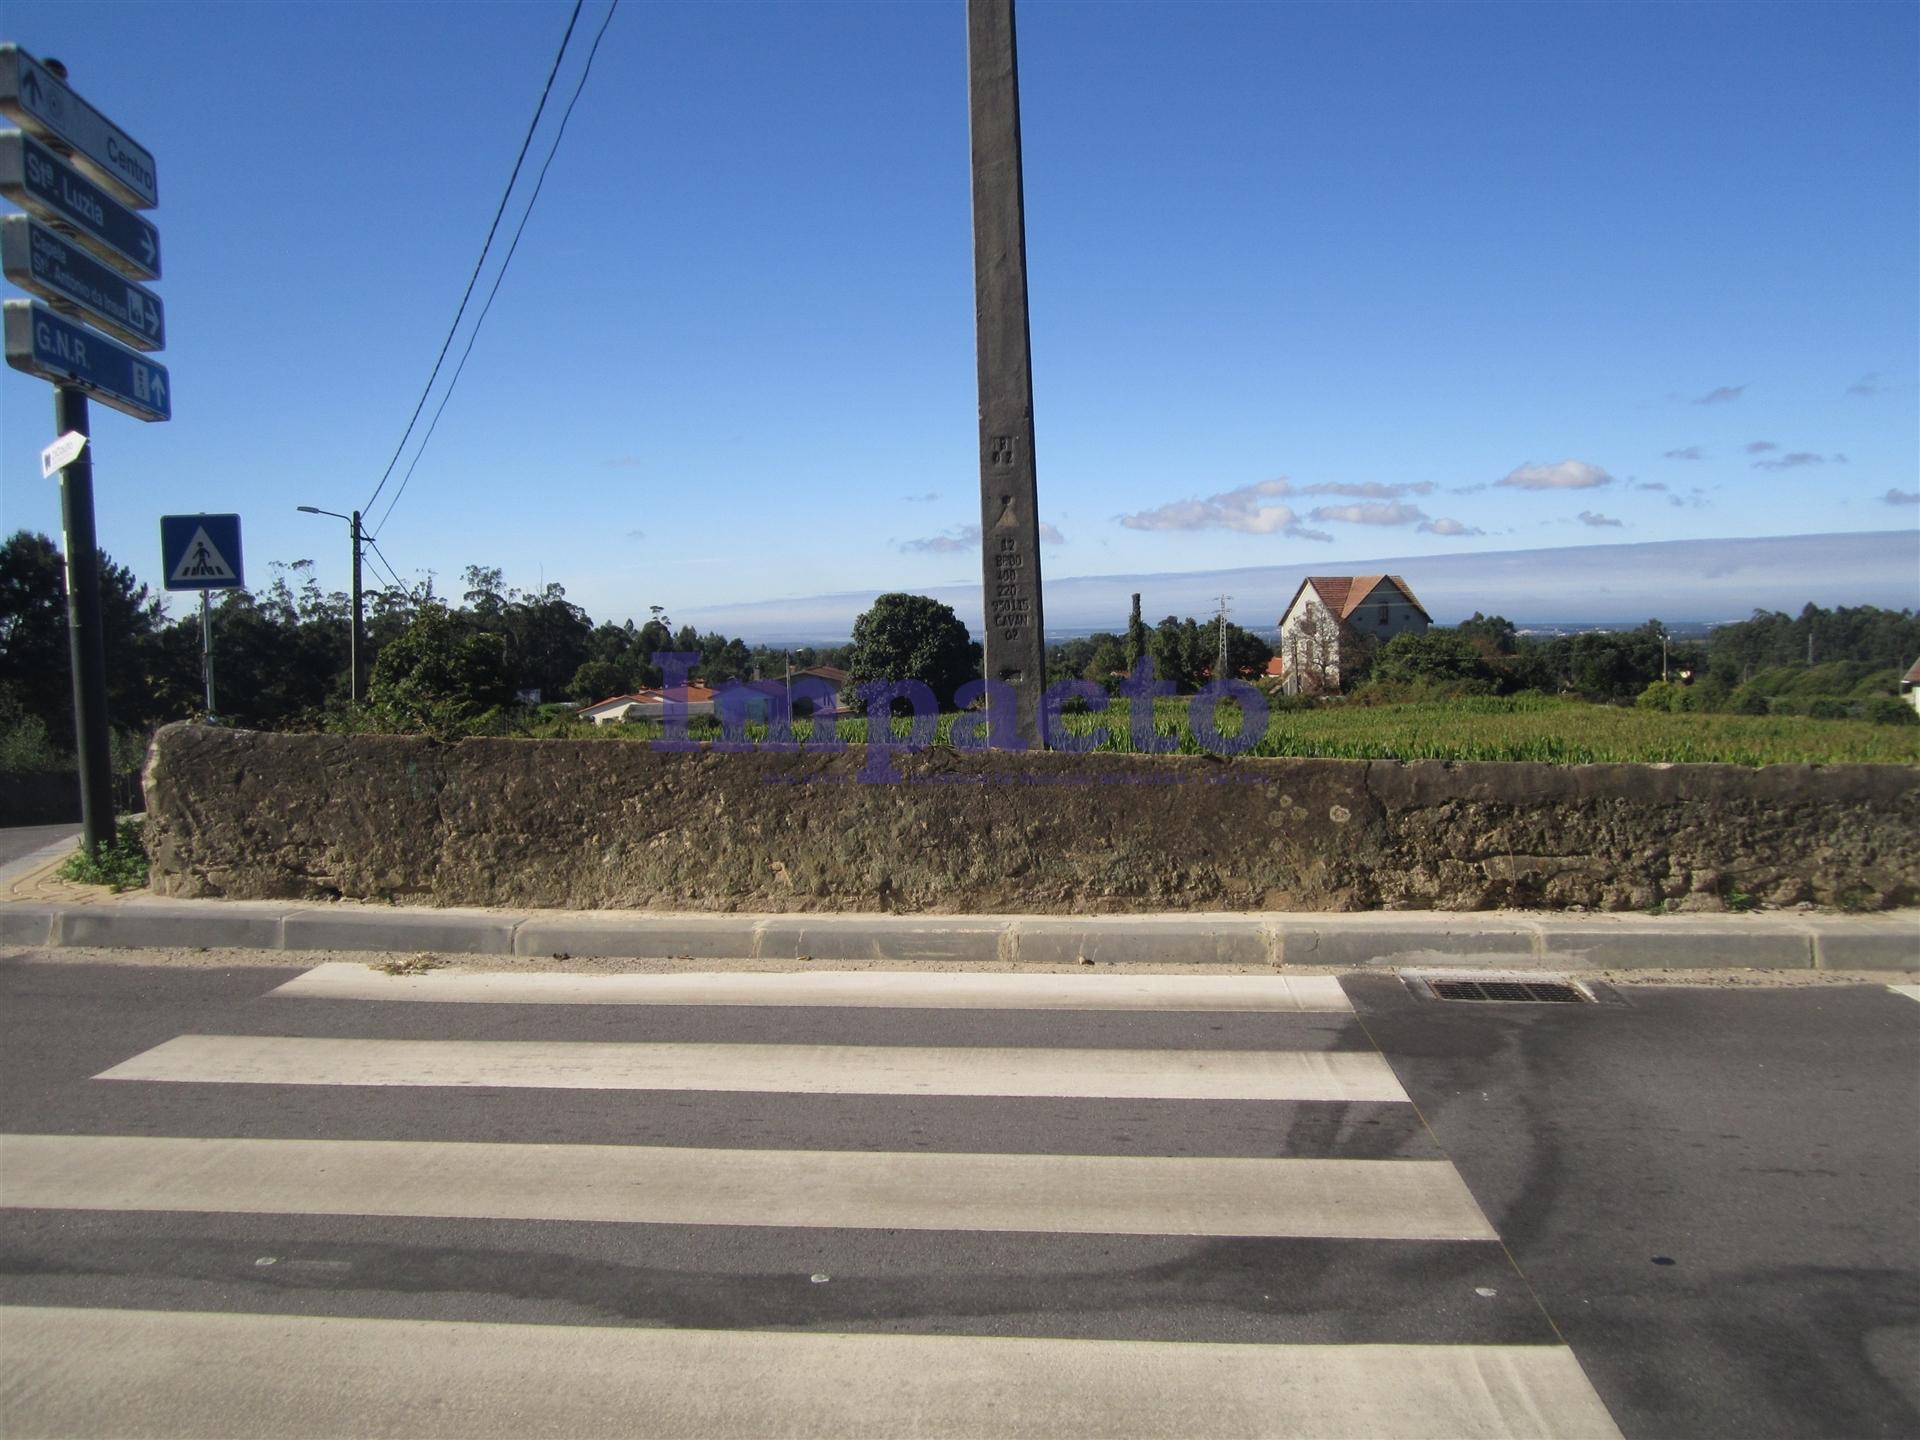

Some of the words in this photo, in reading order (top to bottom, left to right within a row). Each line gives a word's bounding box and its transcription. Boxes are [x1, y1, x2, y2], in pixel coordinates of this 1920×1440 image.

[107, 136, 152, 191] Centro
[62, 174, 104, 227] Luzia
[36, 321, 91, 369] G.N.R.
